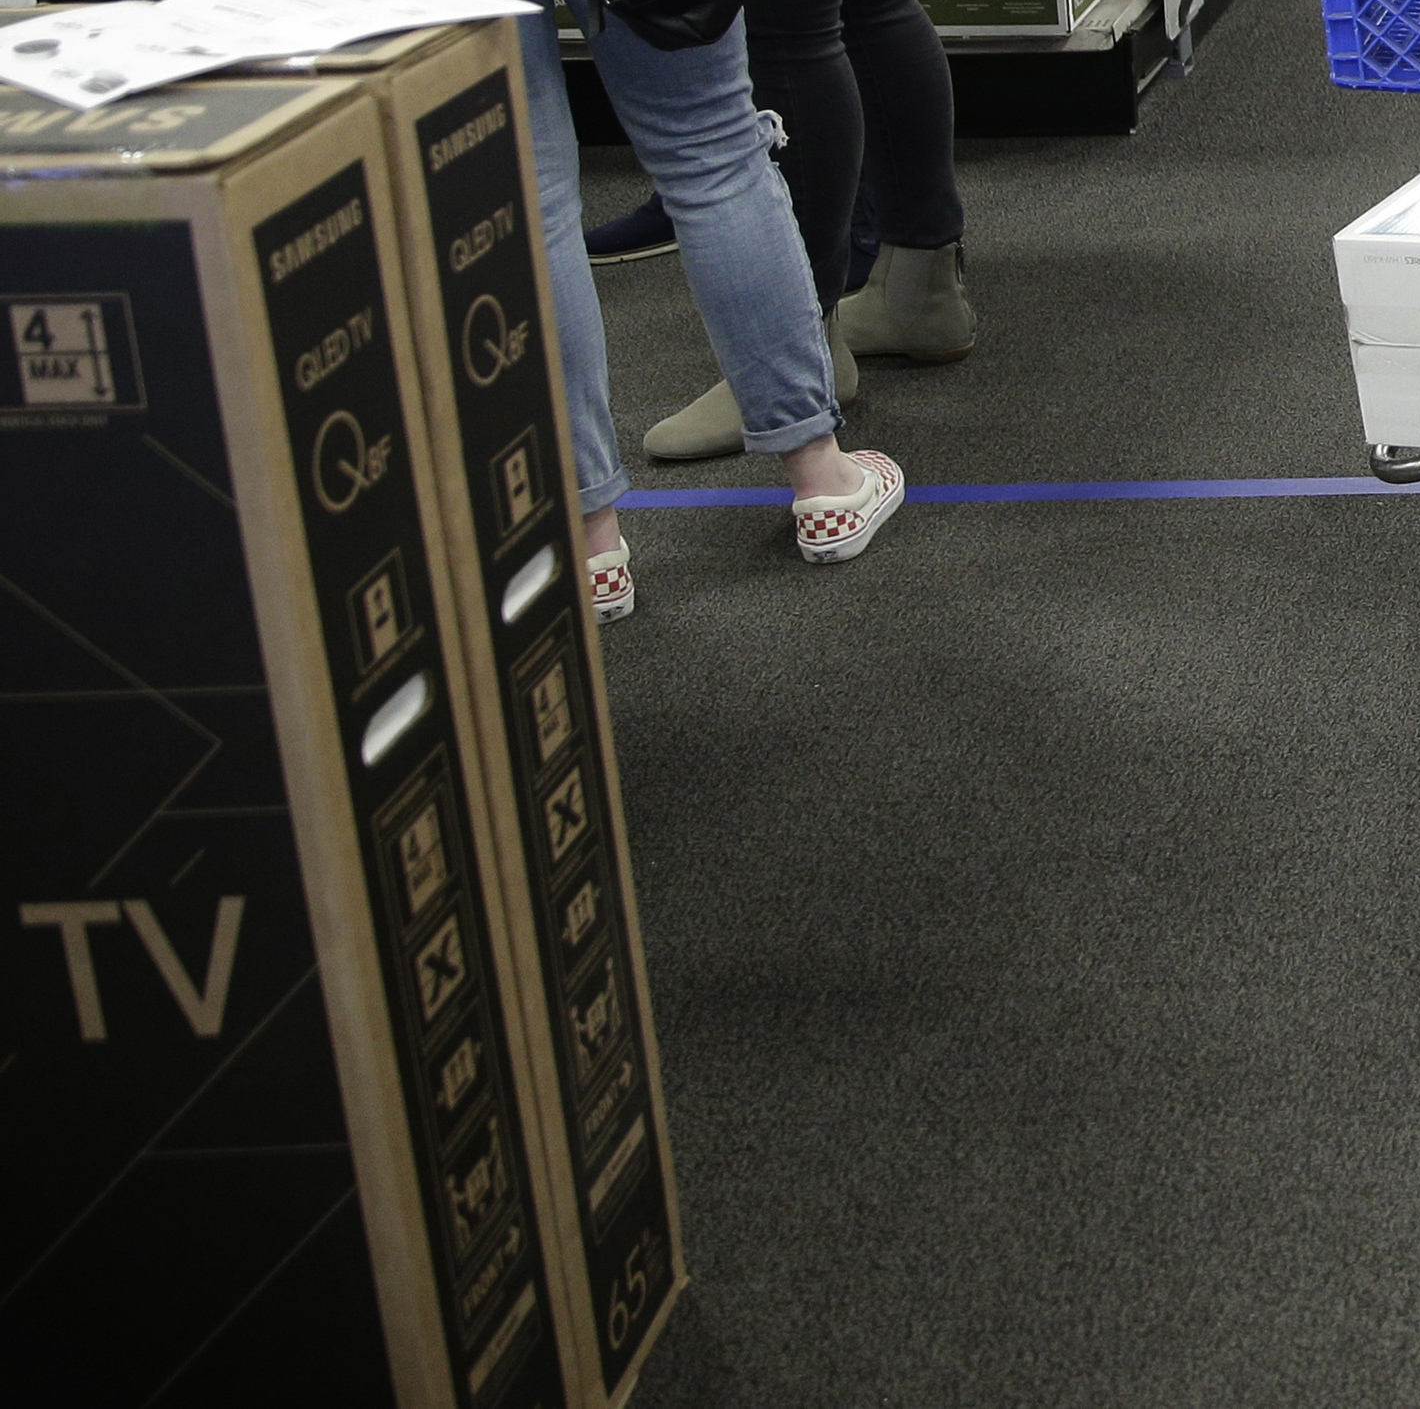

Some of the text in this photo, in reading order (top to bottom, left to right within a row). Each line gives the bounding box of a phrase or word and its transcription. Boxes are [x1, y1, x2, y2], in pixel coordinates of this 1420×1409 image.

[428, 101, 507, 173] SAMSUNG
[269, 197, 364, 284] SAMSUNG
[450, 219, 495, 274] QLED
[23, 308, 55, 352] 4
[296, 328, 351, 392] QLED
[30, 356, 81, 381] MAX
[19, 895, 246, 1043] TV
